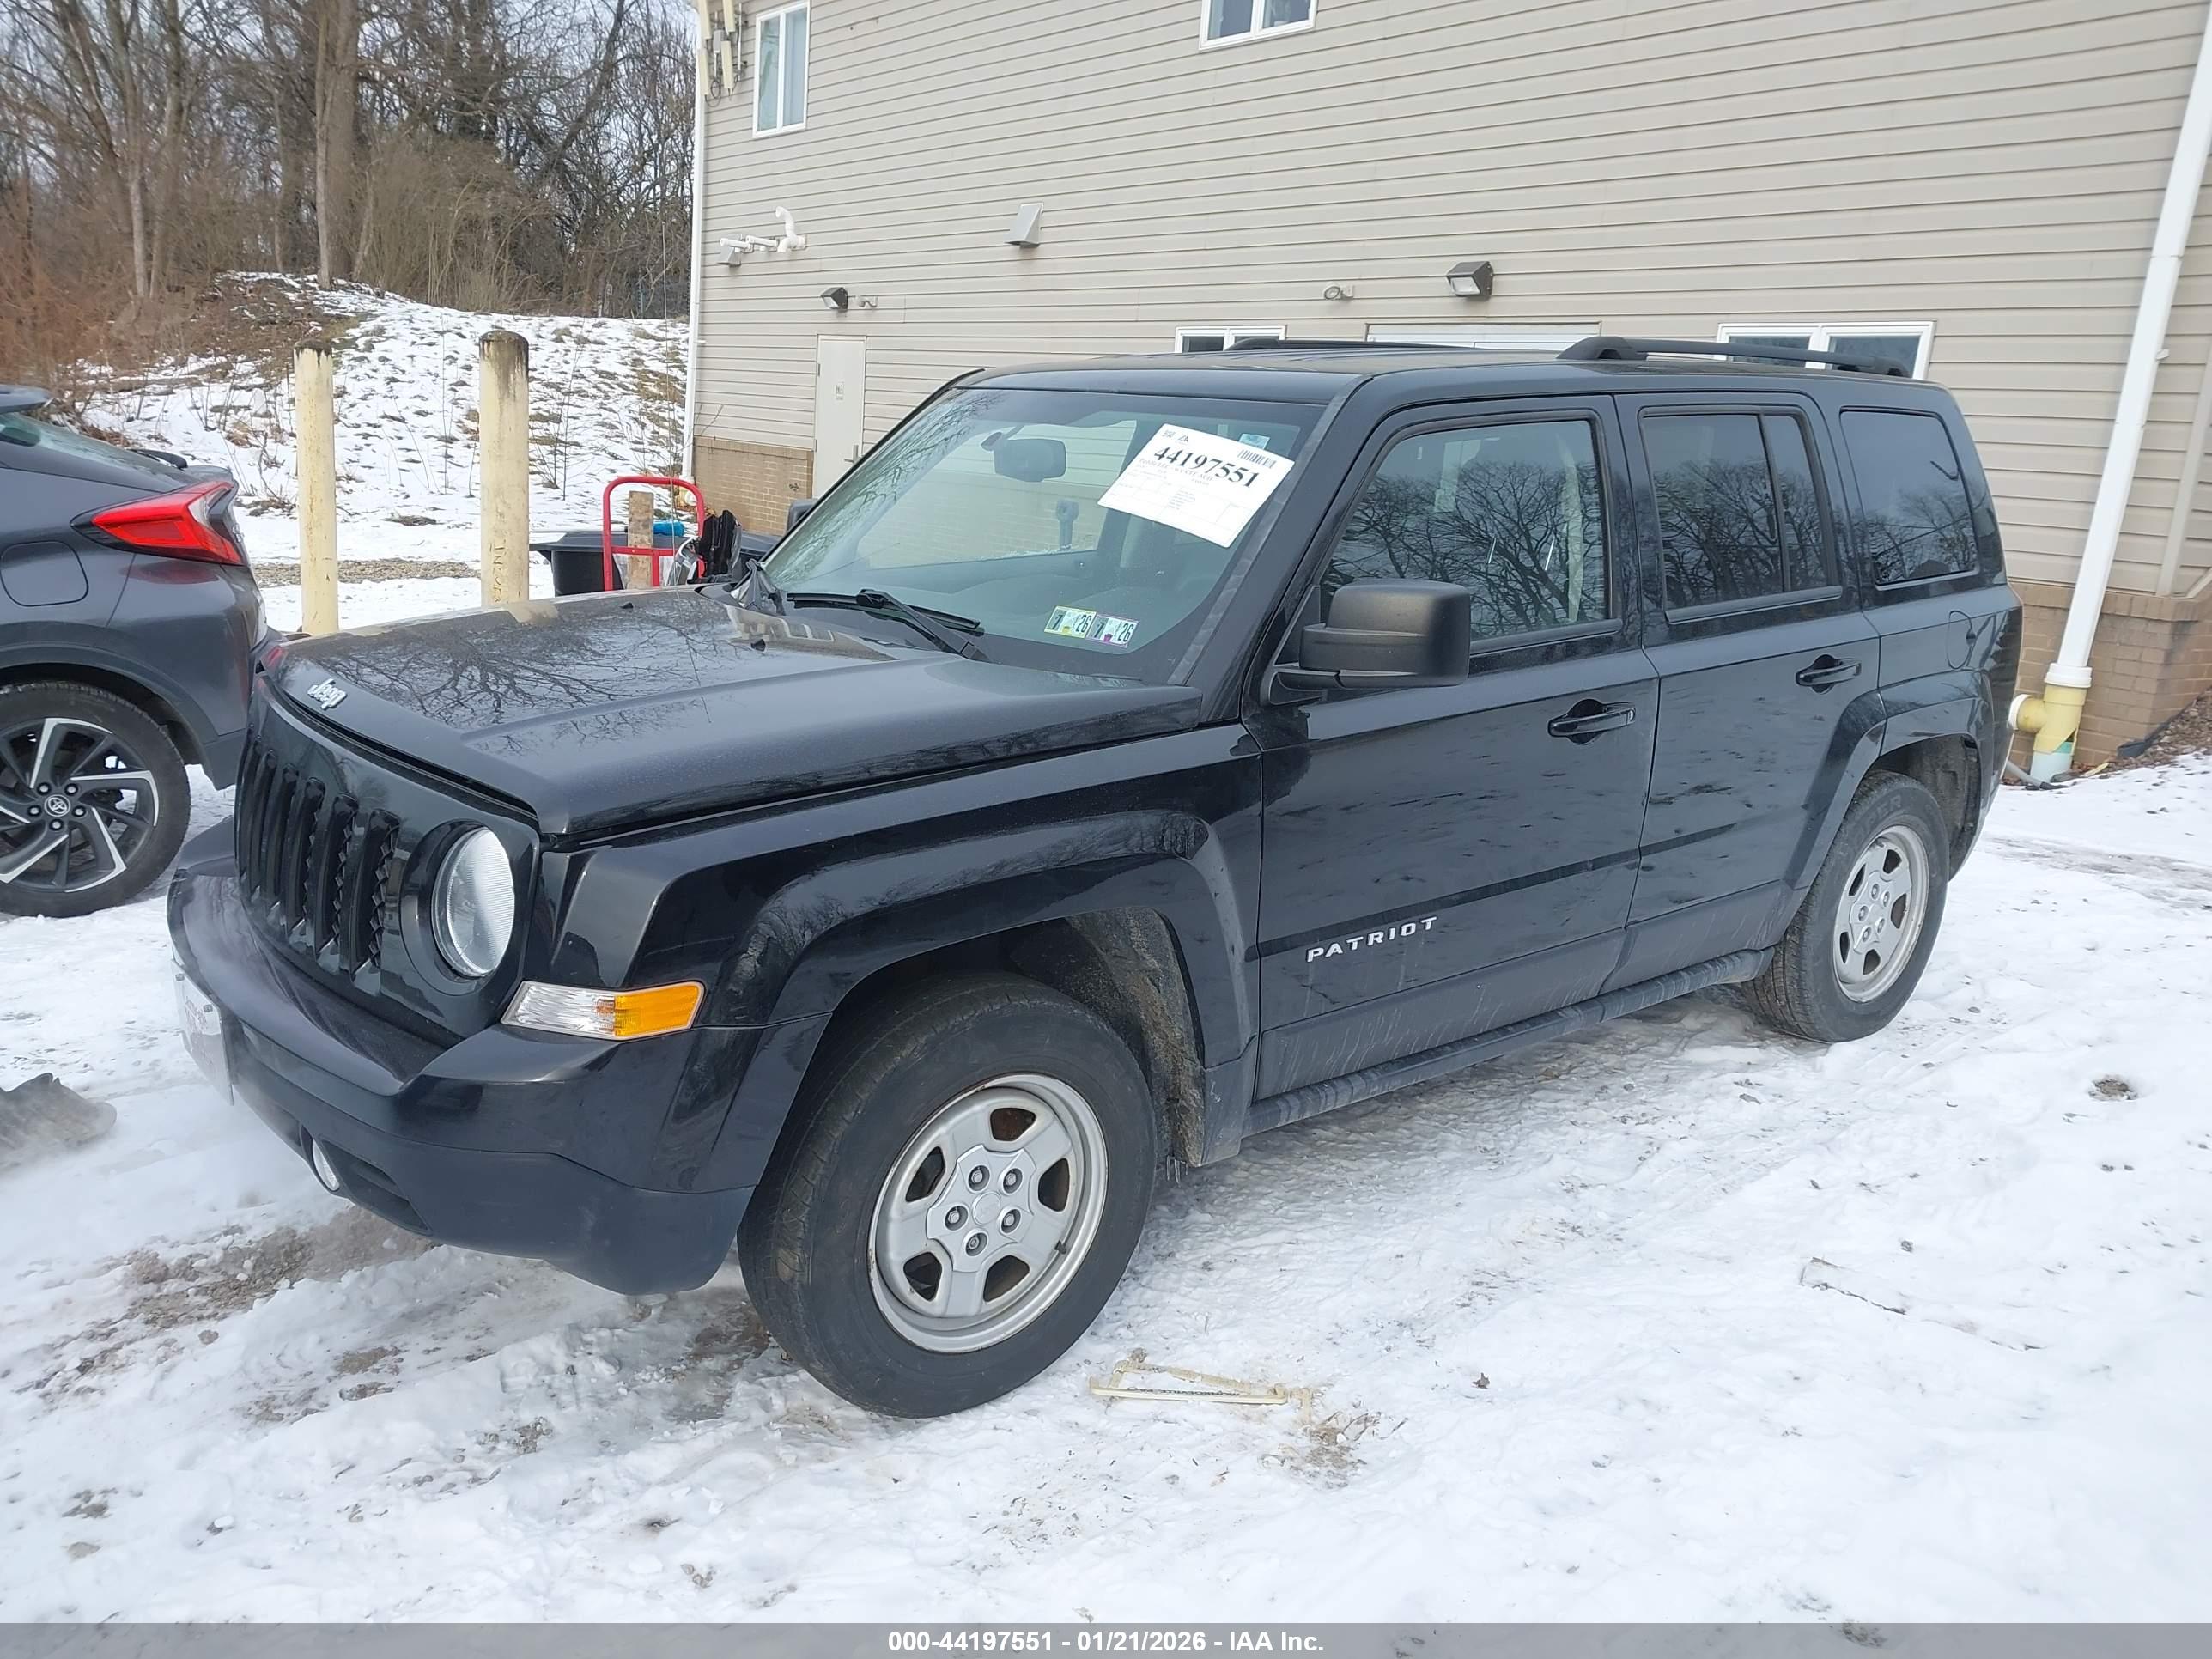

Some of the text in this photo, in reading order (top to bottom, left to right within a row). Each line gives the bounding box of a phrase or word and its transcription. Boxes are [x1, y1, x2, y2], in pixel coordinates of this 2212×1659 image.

[1154, 446, 1260, 489] 44197551
[1076, 614, 1092, 633] 26
[1117, 623, 1134, 641] 26
[1307, 916, 1437, 963] PATRIOT
